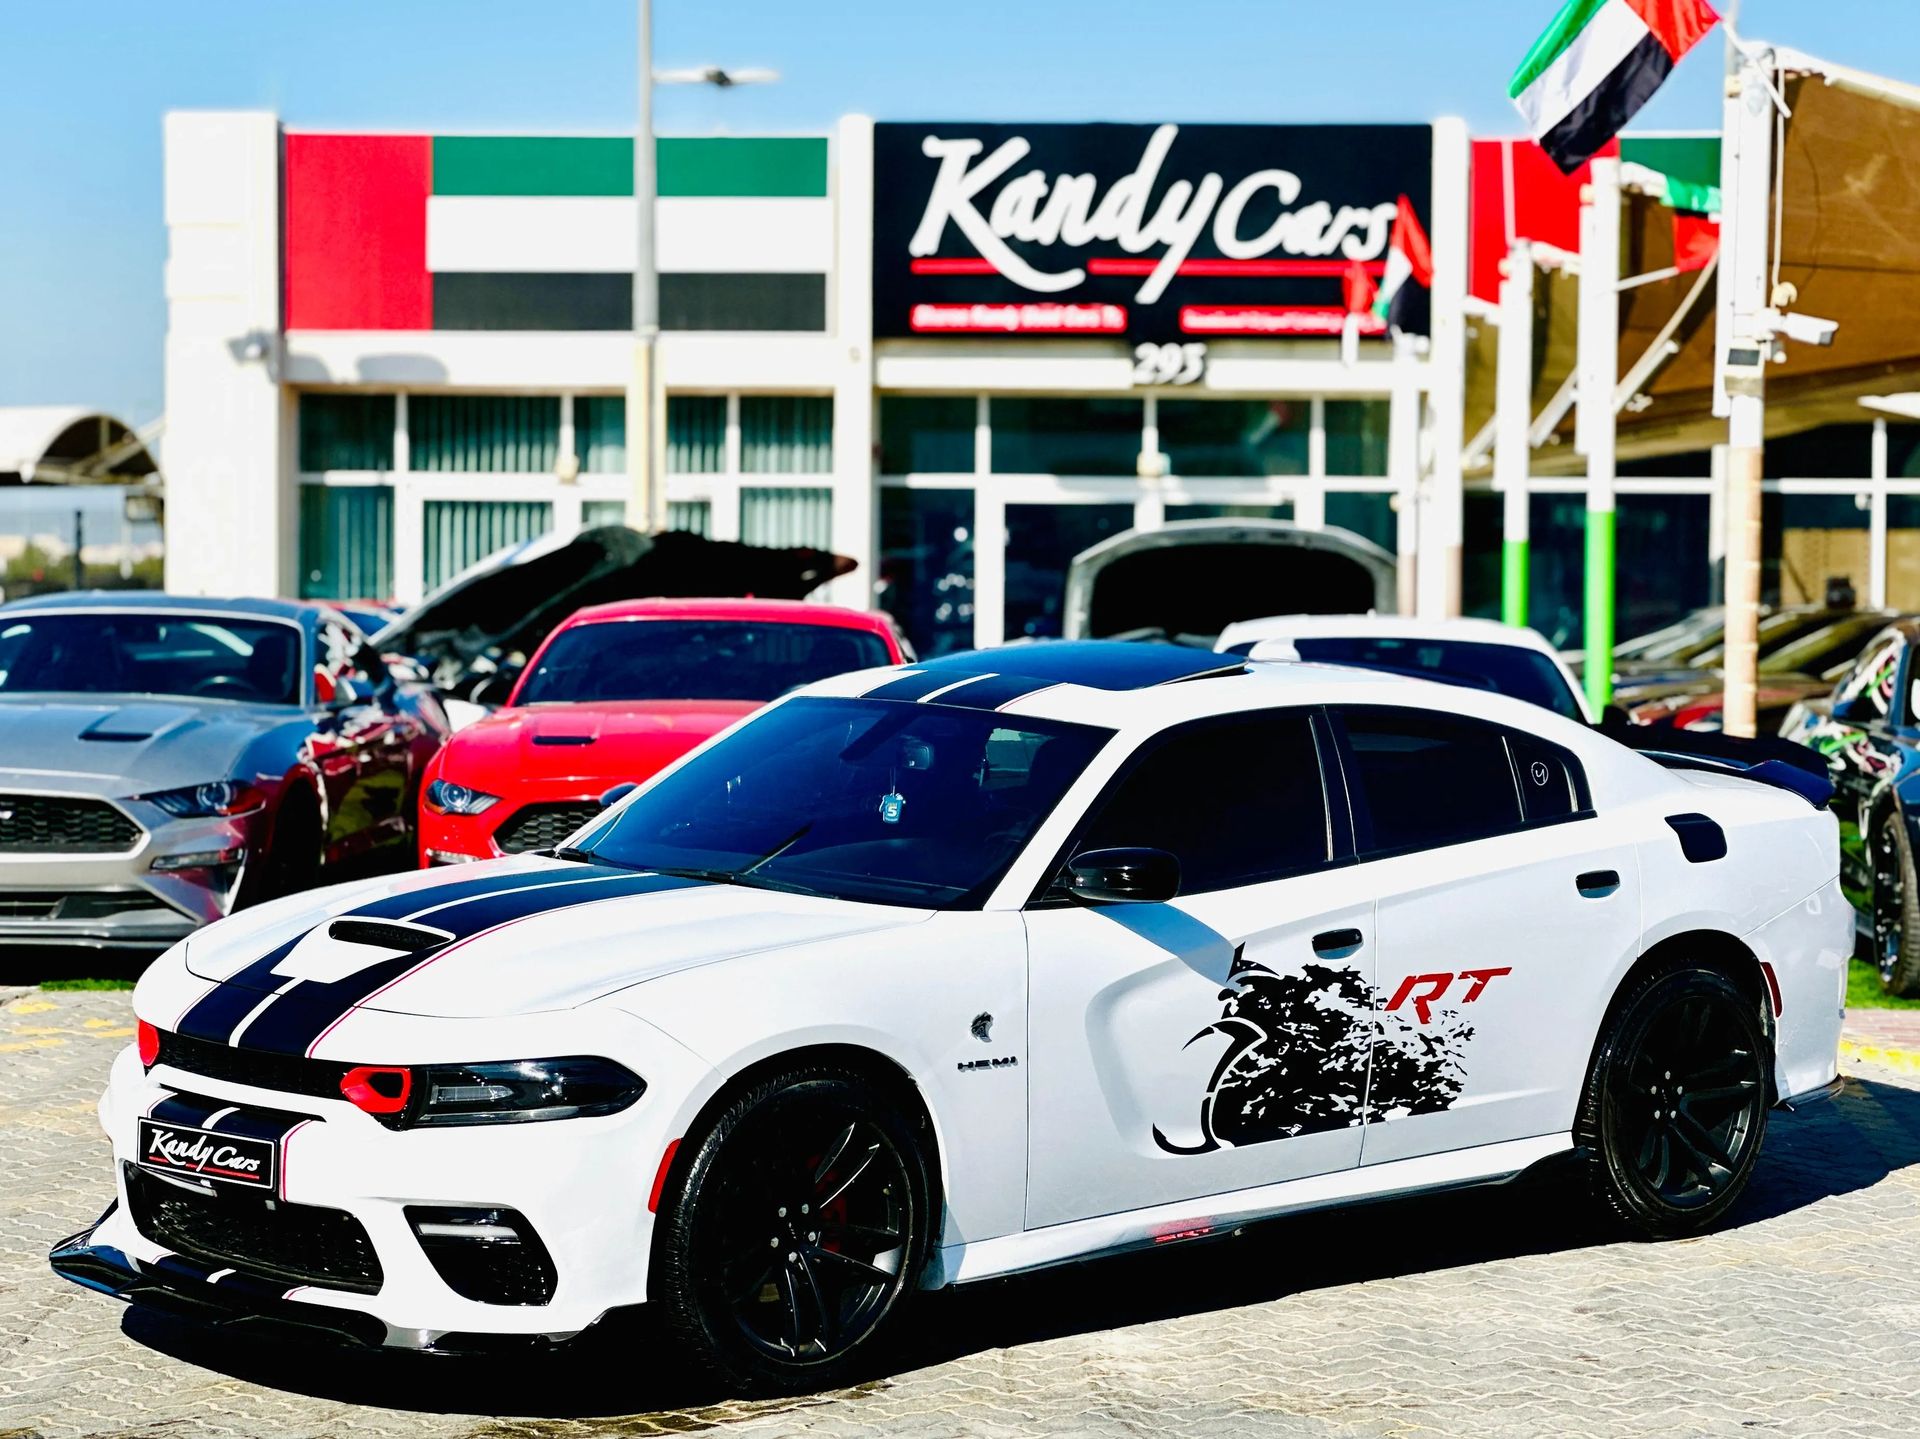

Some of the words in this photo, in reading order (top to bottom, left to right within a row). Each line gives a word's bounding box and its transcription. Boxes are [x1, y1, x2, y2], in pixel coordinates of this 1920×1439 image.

[909, 124, 1223, 303] Kandy
[1212, 169, 1397, 260] Cars
[1133, 342, 1207, 385] 295
[1384, 966, 1512, 1025] RT
[957, 1056, 1018, 1072] HEMI
[149, 1128, 214, 1172] Kandy
[212, 1146, 260, 1171] Cars
